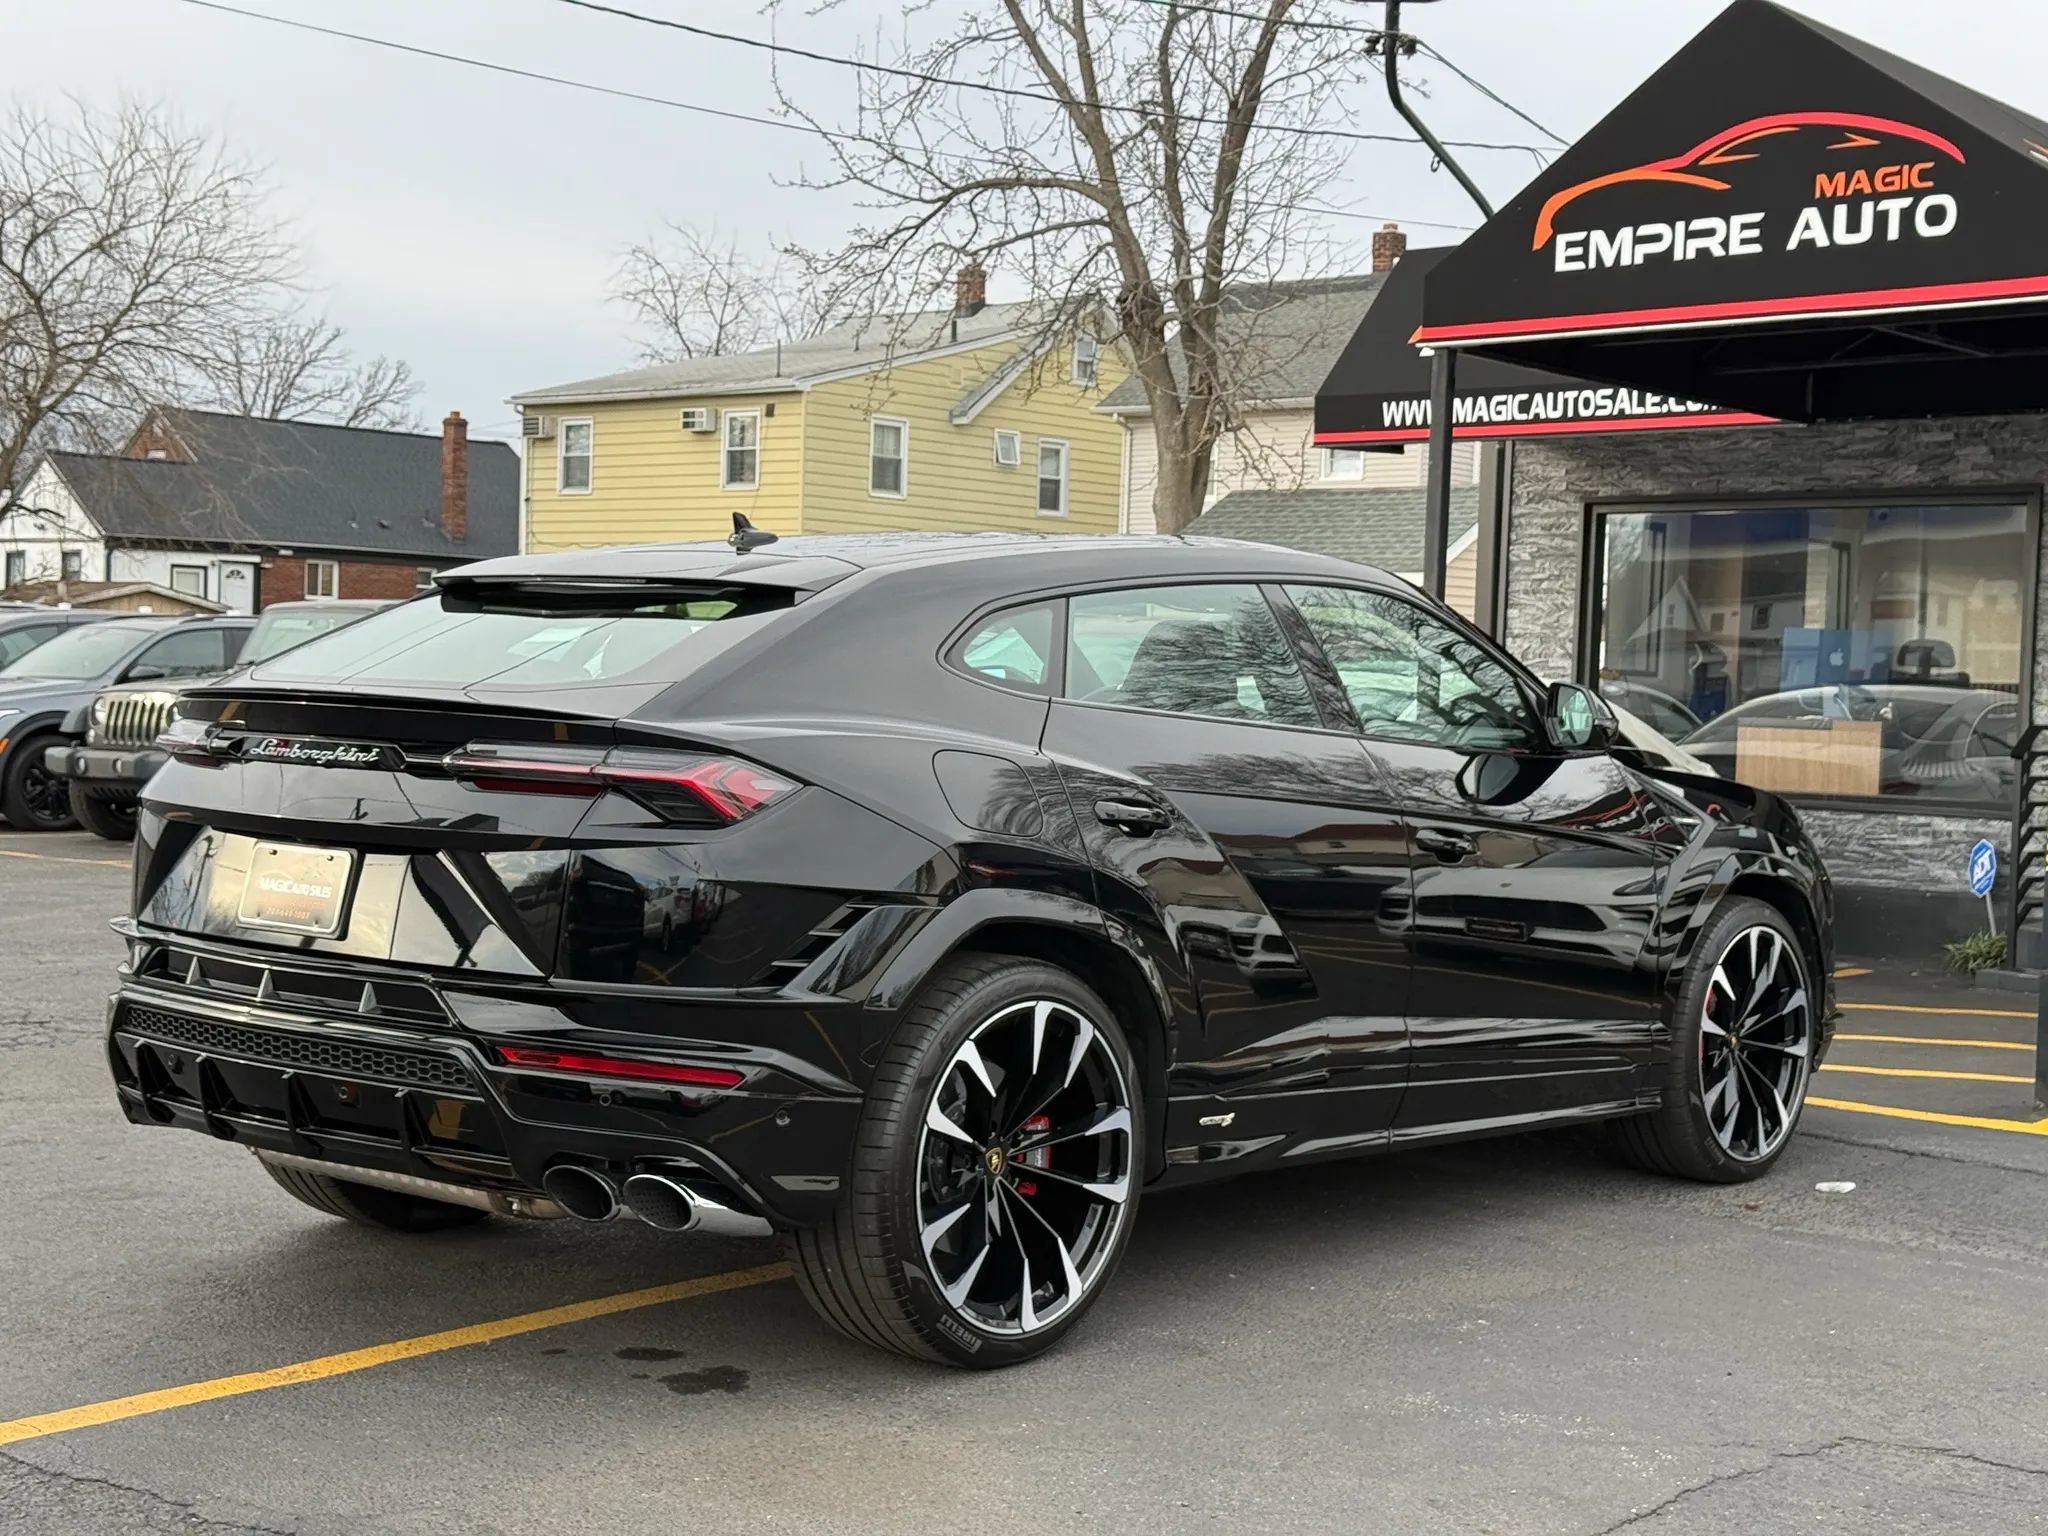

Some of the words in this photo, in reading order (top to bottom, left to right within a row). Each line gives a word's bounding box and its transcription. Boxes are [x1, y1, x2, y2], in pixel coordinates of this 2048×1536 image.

[1815, 161, 1935, 199] MAGIC
[1554, 212, 1765, 272] EMPIRE
[1786, 193, 1958, 251] AUTO
[249, 738, 381, 764] Lamborghini
[1972, 848, 1992, 885] ADT
